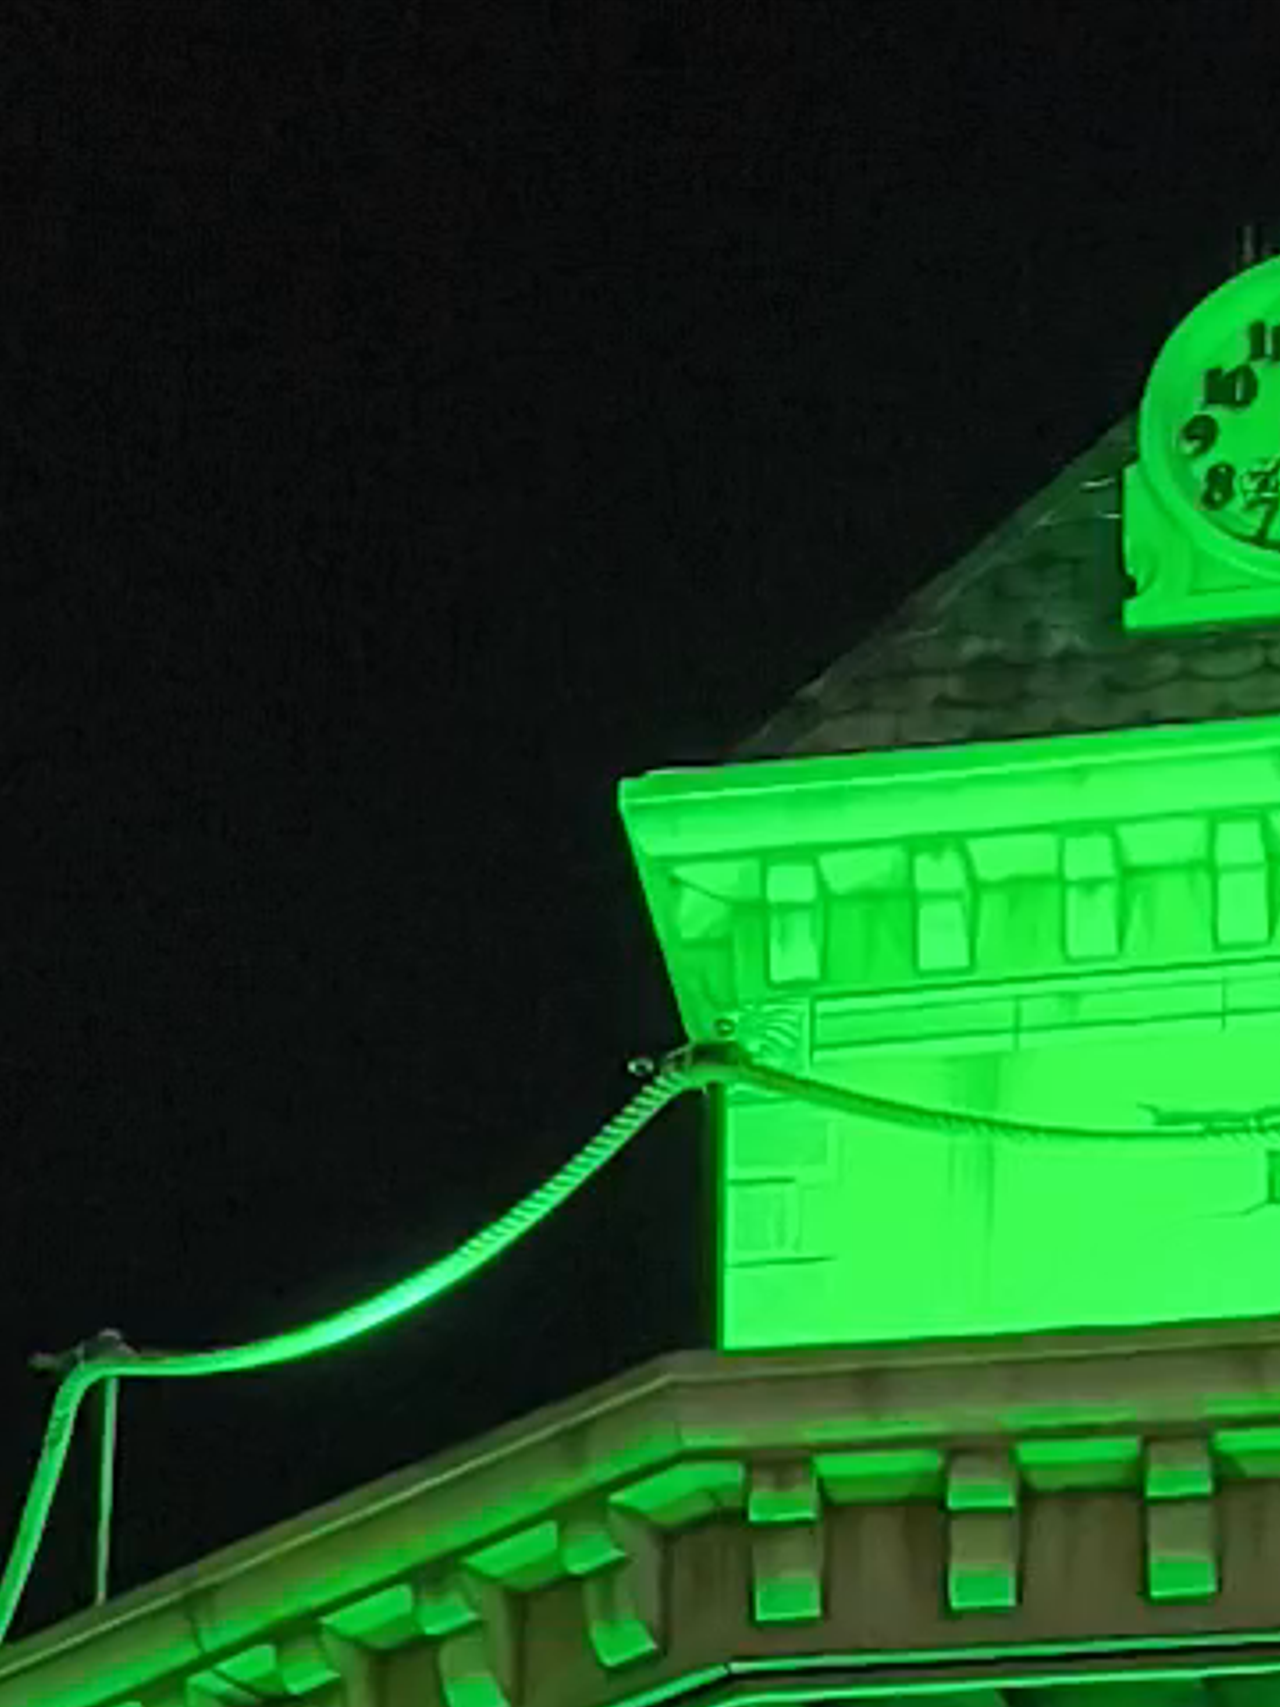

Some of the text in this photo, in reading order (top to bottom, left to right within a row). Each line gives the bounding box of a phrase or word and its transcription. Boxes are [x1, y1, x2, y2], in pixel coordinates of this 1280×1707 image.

[1203, 365, 1258, 406] 10
[1180, 414, 1219, 456] 9
[1200, 462, 1236, 511] 8
